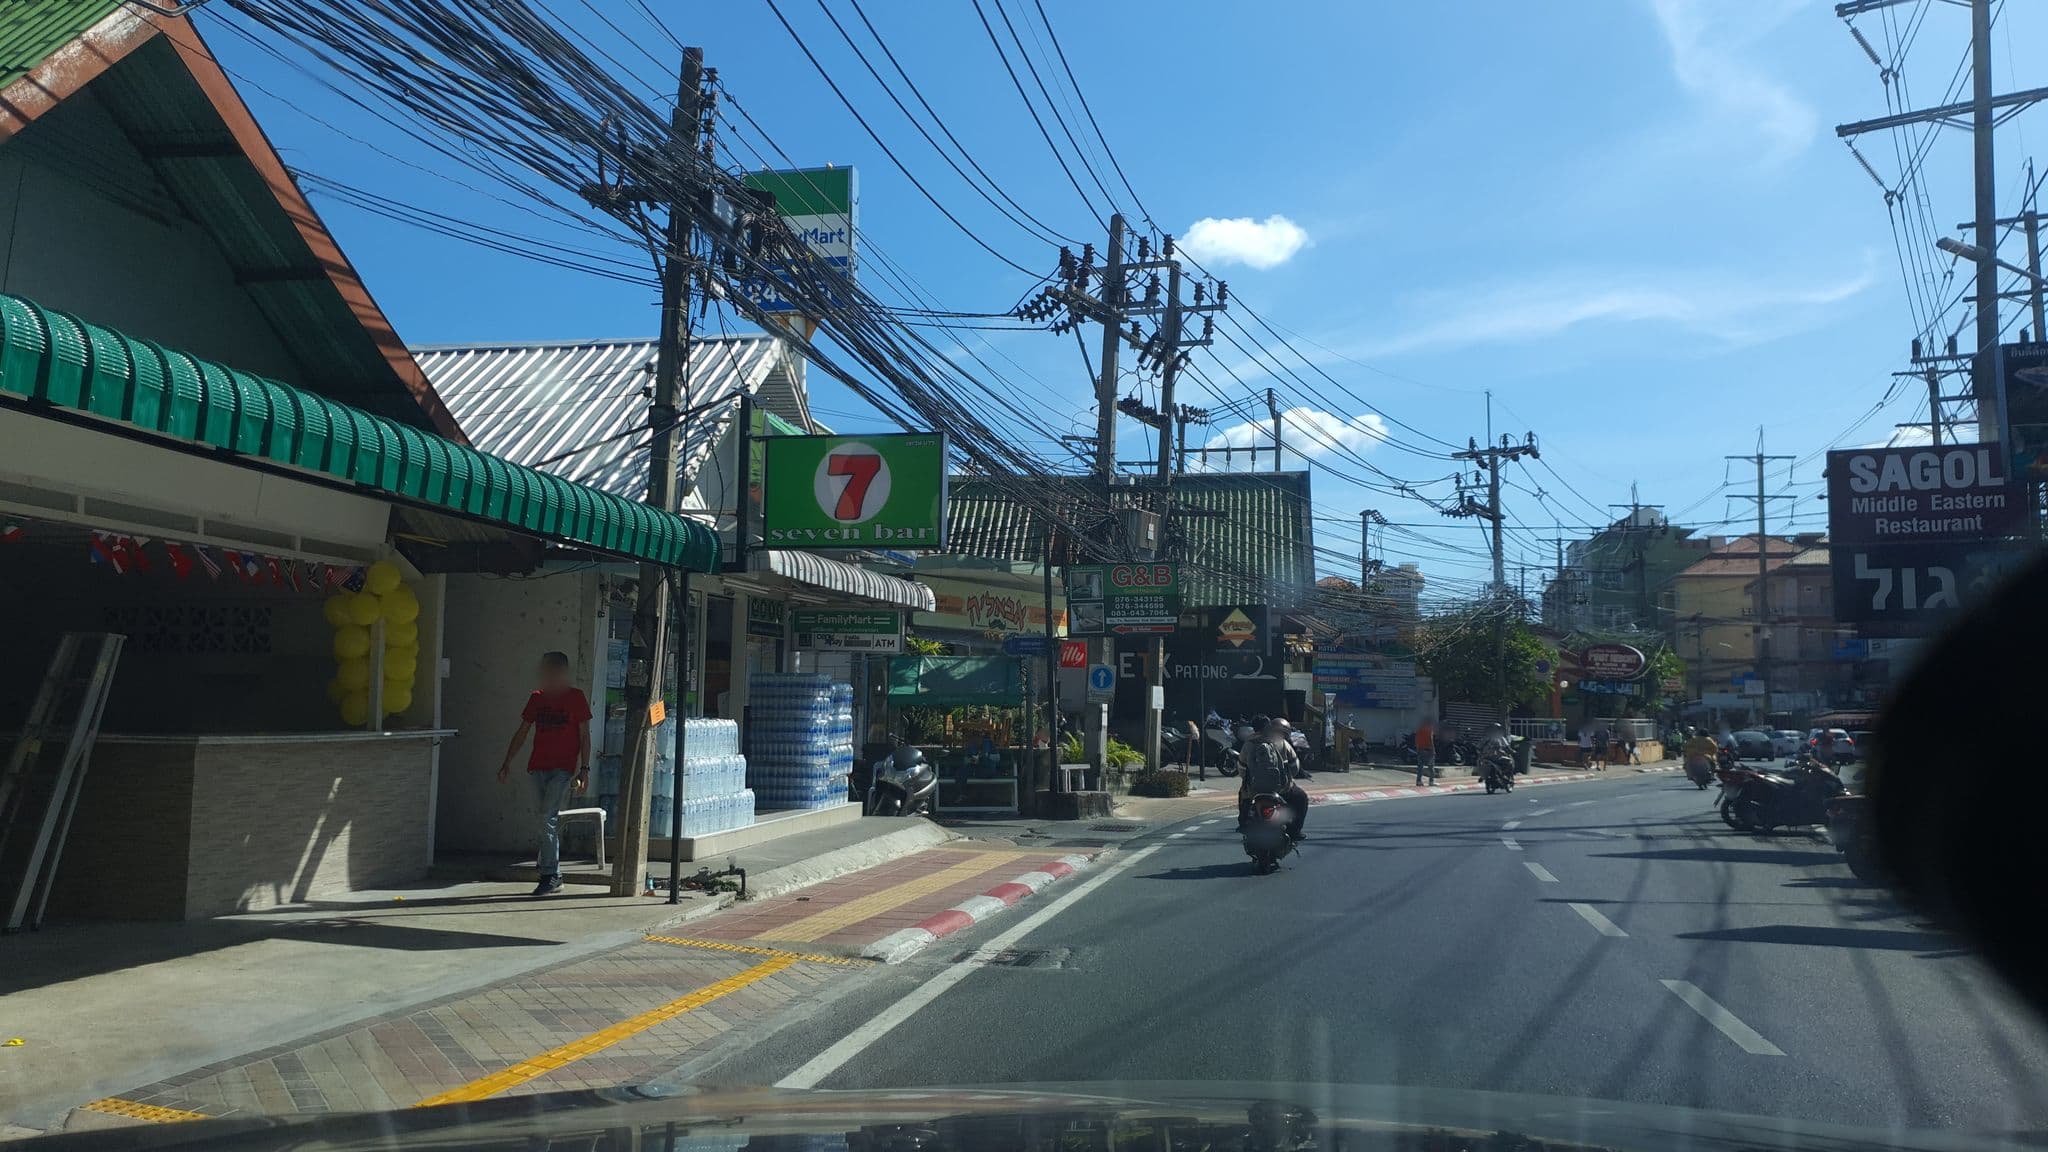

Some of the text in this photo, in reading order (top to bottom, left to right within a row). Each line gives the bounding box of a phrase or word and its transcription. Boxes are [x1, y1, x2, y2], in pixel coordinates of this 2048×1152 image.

[1849, 450, 2004, 493] SAGOL
[828, 455, 881, 519] 7
[1852, 493, 2005, 514] Middle Eastern
[771, 524, 933, 541] seven bar
[1876, 514, 1983, 534] Restaurant
[1112, 564, 1172, 587] G&B
[817, 614, 872, 625] FamilyMart
[875, 640, 895, 648] ATM
[1062, 646, 1085, 665] illy
[1175, 664, 1228, 679] PATONG
